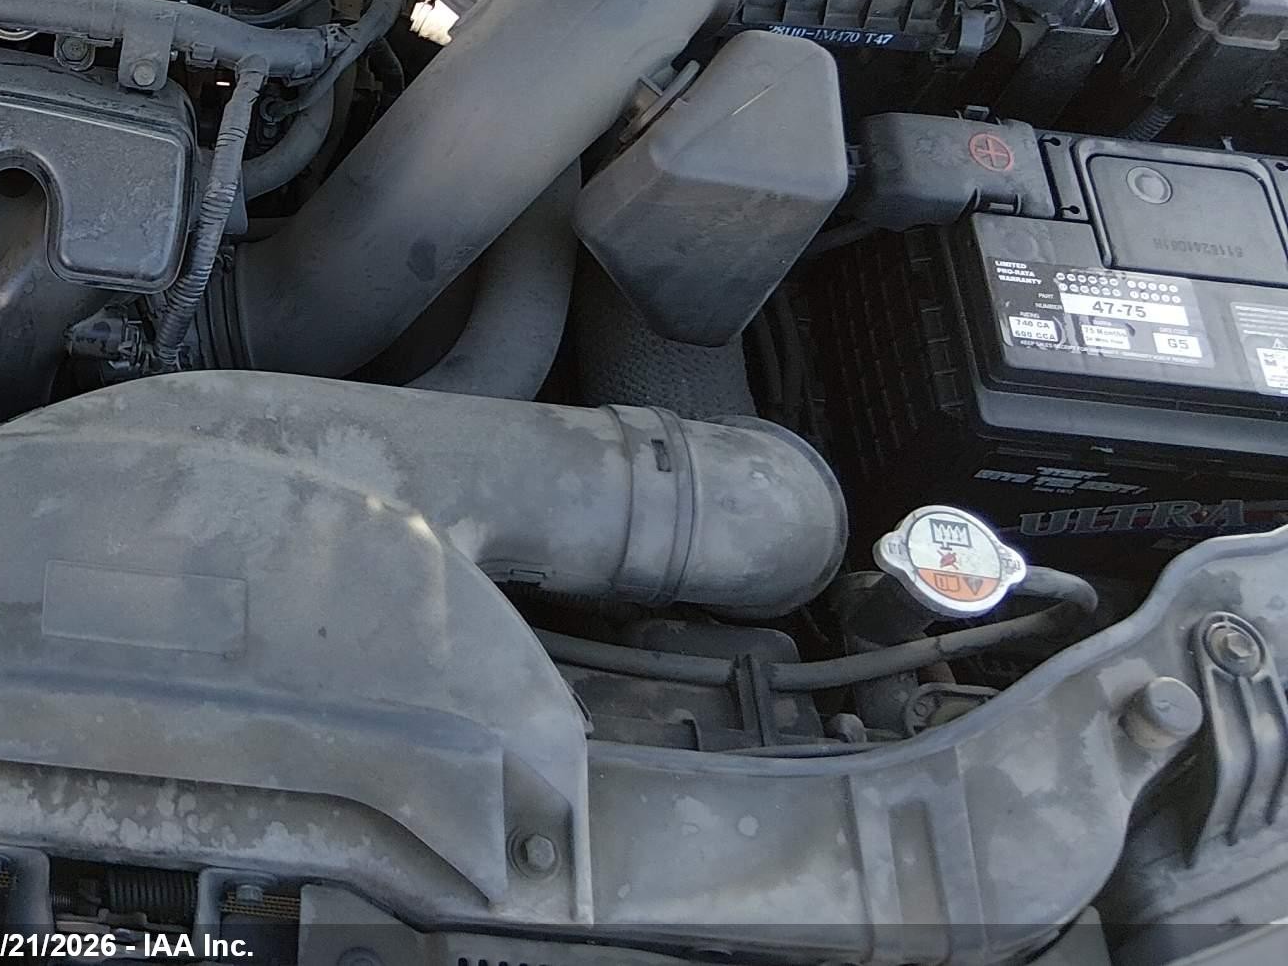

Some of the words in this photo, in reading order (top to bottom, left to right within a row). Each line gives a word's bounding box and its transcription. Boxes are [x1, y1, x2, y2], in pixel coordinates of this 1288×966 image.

[864, 33, 894, 45] T47
[1092, 301, 1147, 318] 47-75
[1037, 321, 1050, 329] CA
[1036, 332, 1056, 340] CCA
[1167, 338, 1190, 350] G5
[1020, 499, 1247, 535] ULTRA
